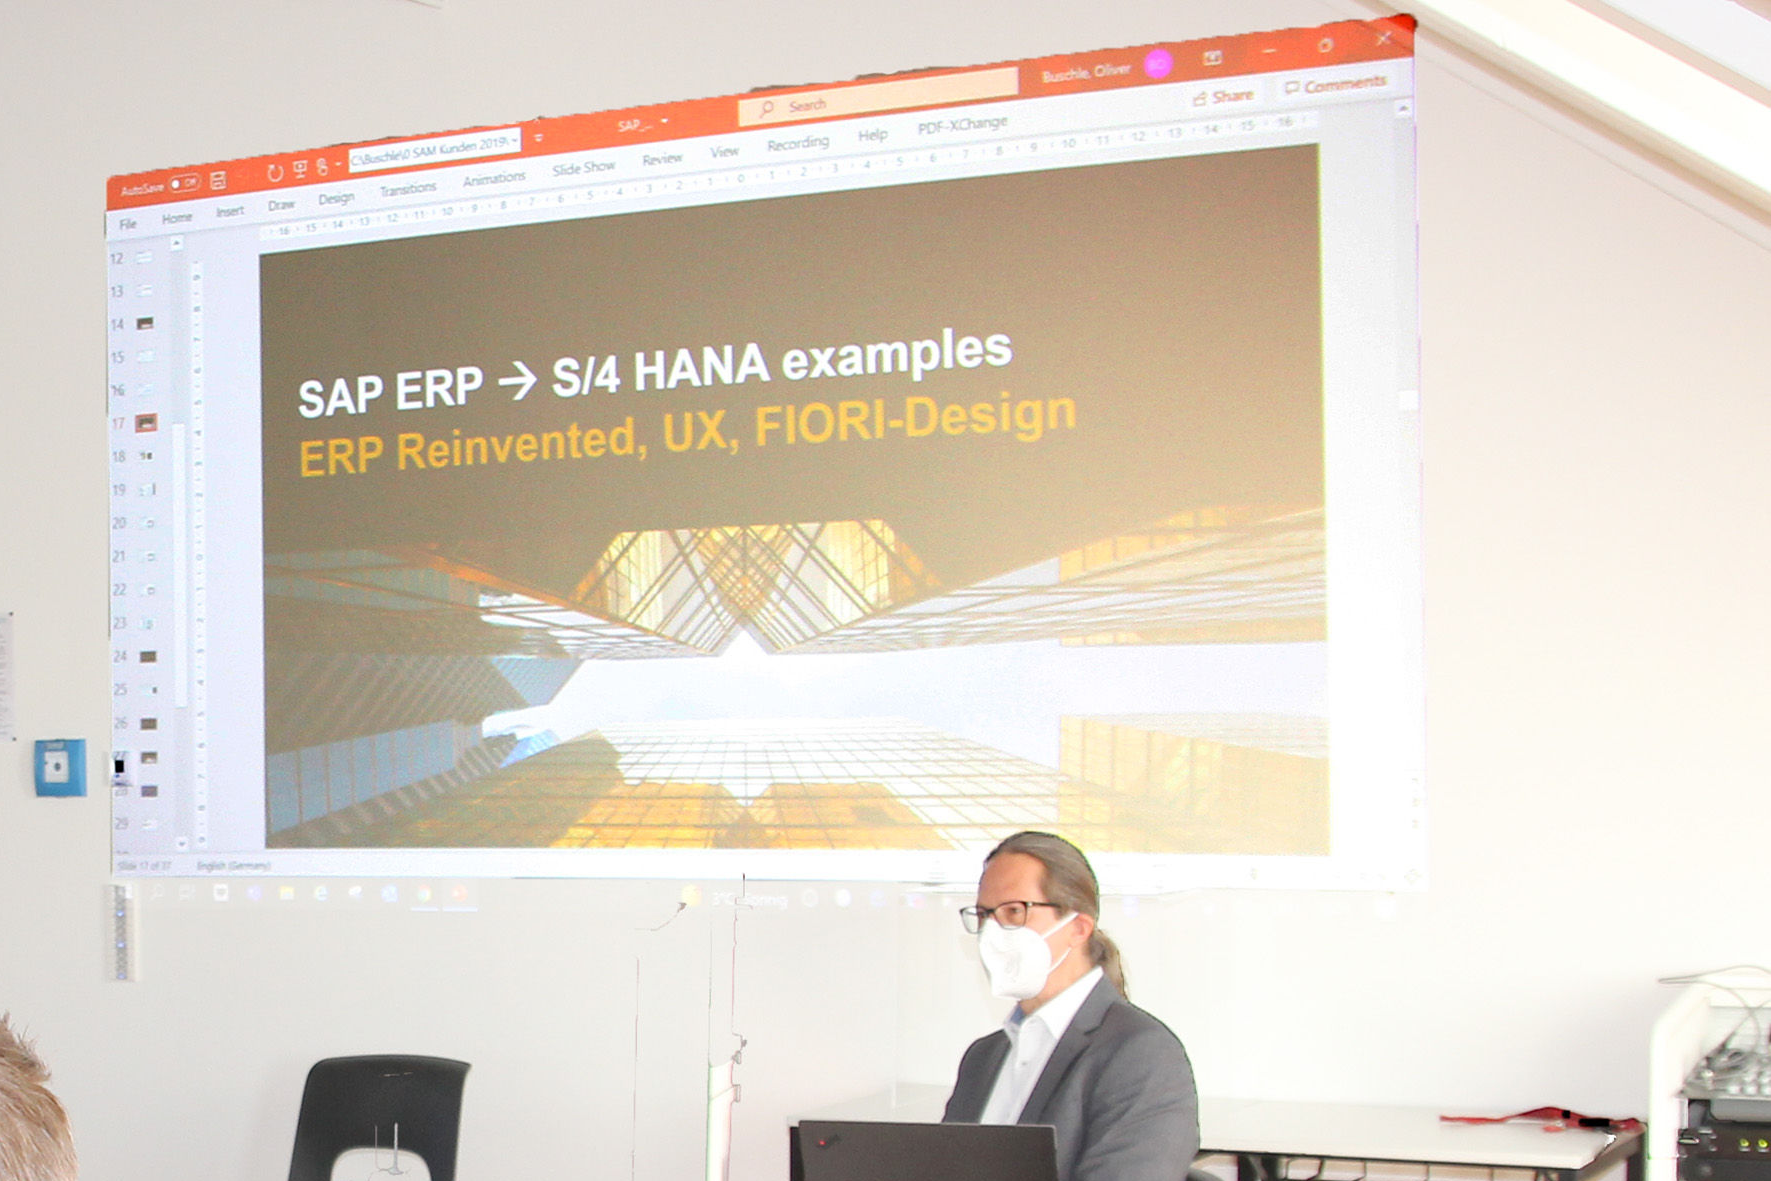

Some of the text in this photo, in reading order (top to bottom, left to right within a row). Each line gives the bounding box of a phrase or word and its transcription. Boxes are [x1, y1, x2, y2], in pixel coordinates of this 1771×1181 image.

[1093, 63, 1132, 78] Oliver
[1304, 74, 1388, 94] Comments
[1212, 88, 1255, 104] Share
[788, 98, 827, 113] Search
[412, 146, 437, 159] SAM
[439, 141, 477, 155] Kunden
[119, 114, 1009, 231] File Home Insert Draw Design Transitions Animations Slide Show Review View Recording Help PDF-XChange
[120, 182, 165, 197] AutoSave
[111, 253, 124, 265] 12
[111, 285, 124, 297] 13
[111, 318, 124, 331] 14
[111, 351, 124, 364] 15
[297, 327, 1013, 419] SAP ERP S/4 HANA examples
[111, 385, 125, 397] 16
[112, 417, 125, 430] 17
[299, 390, 1077, 478] ERP Reinvented, UX, FIORI-Design
[112, 450, 126, 463] 18
[113, 483, 126, 496] 19
[112, 516, 127, 529] 20
[112, 549, 125, 563] 21
[112, 583, 126, 596] 22
[113, 616, 127, 630] 23
[113, 650, 127, 663] 24
[113, 683, 128, 697] 25
